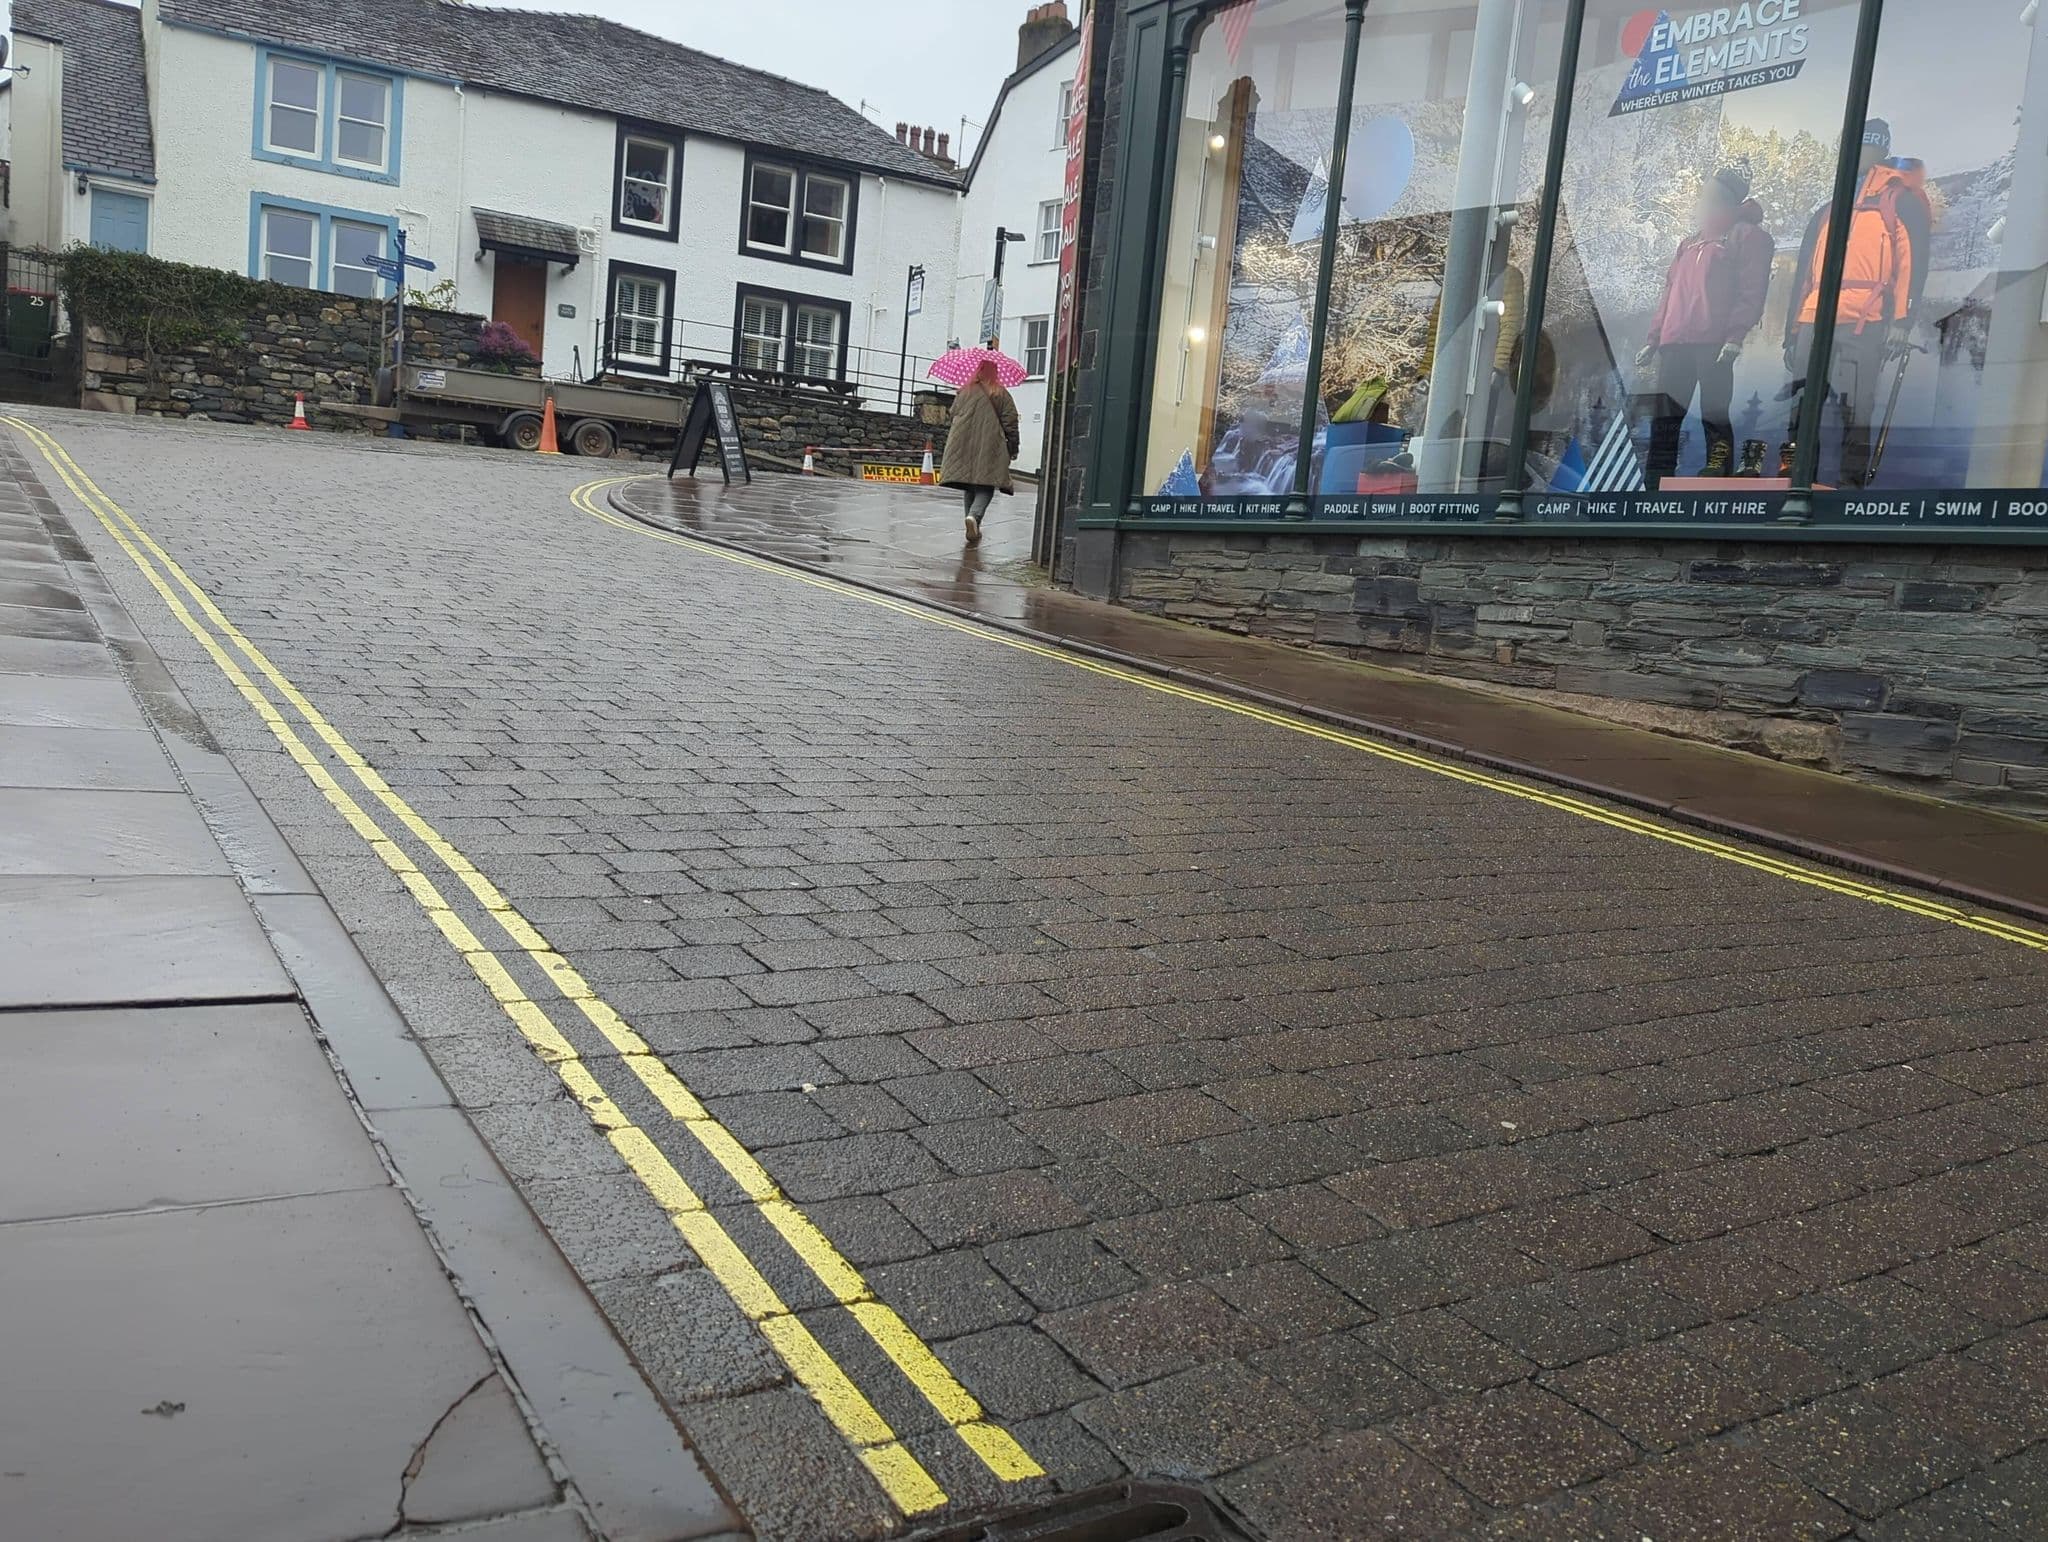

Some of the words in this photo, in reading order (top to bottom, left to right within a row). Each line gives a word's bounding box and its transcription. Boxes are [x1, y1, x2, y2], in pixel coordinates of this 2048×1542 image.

[1650, 0, 1800, 53] EMBRACE
[1628, 65, 1653, 90] the
[1654, 23, 1809, 85] ELEMENTS
[1621, 91, 1679, 112] WHEREVER
[1682, 80, 1725, 100] WINTER
[1727, 72, 1766, 91] TAKES
[1769, 65, 1797, 81] YOU
[30, 295, 45, 307] 25
[863, 465, 922, 478] METCAL
[1150, 503, 1171, 514] CAMP
[1179, 503, 1198, 514] HIKE
[1207, 503, 1236, 514] TRAVEL
[1246, 503, 1259, 514] KIT
[1261, 503, 1281, 514] HIRE
[1323, 503, 1359, 514] PADDLE
[1371, 503, 1397, 514] SWIM
[1409, 503, 1437, 514] BOOT
[1438, 503, 1480, 514] FITTING
[1536, 502, 1571, 514] CAMP
[1586, 502, 1617, 514] HIKE
[1635, 502, 1685, 514] TRAVEL
[1704, 502, 1729, 514] KIT
[1731, 502, 1767, 514] HIRE
[1844, 502, 1910, 516] PADDLE
[1935, 502, 1982, 516] SWIM
[2008, 502, 2048, 516] BOO
